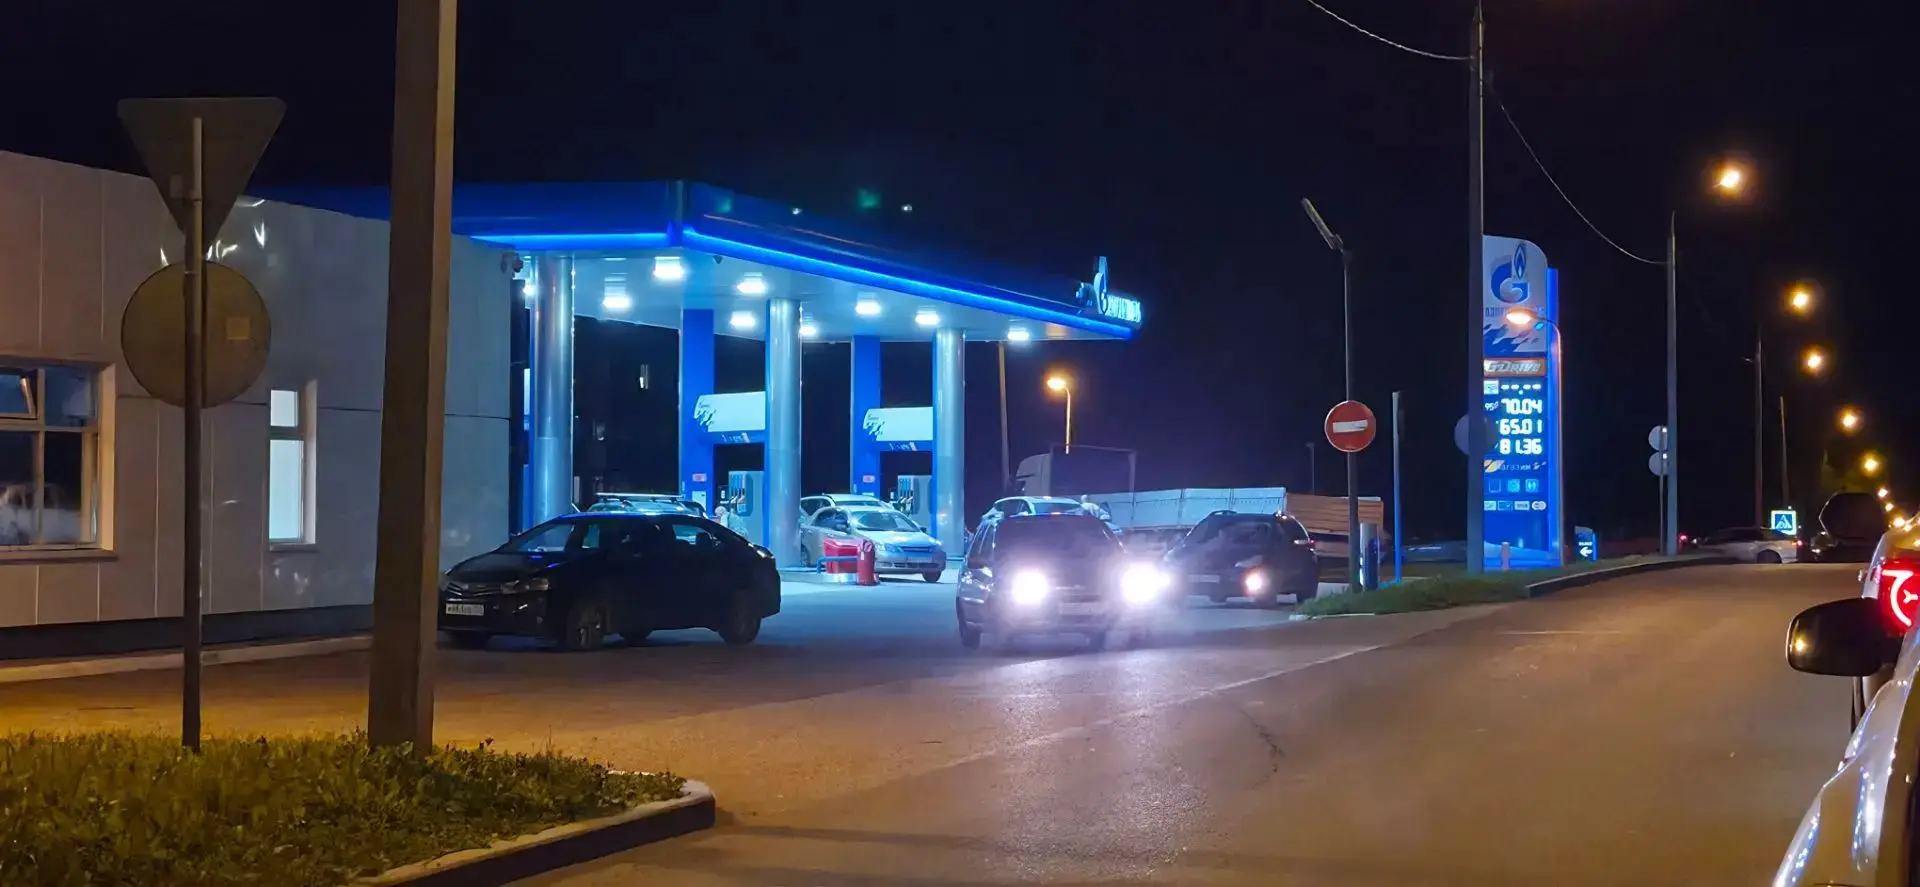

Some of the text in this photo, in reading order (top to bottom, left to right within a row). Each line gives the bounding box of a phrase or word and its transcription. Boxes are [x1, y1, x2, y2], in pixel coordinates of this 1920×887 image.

[1501, 398, 1542, 415] 70.04
[1500, 418, 1542, 435] 65.01
[1500, 438, 1542, 455] 81.36
